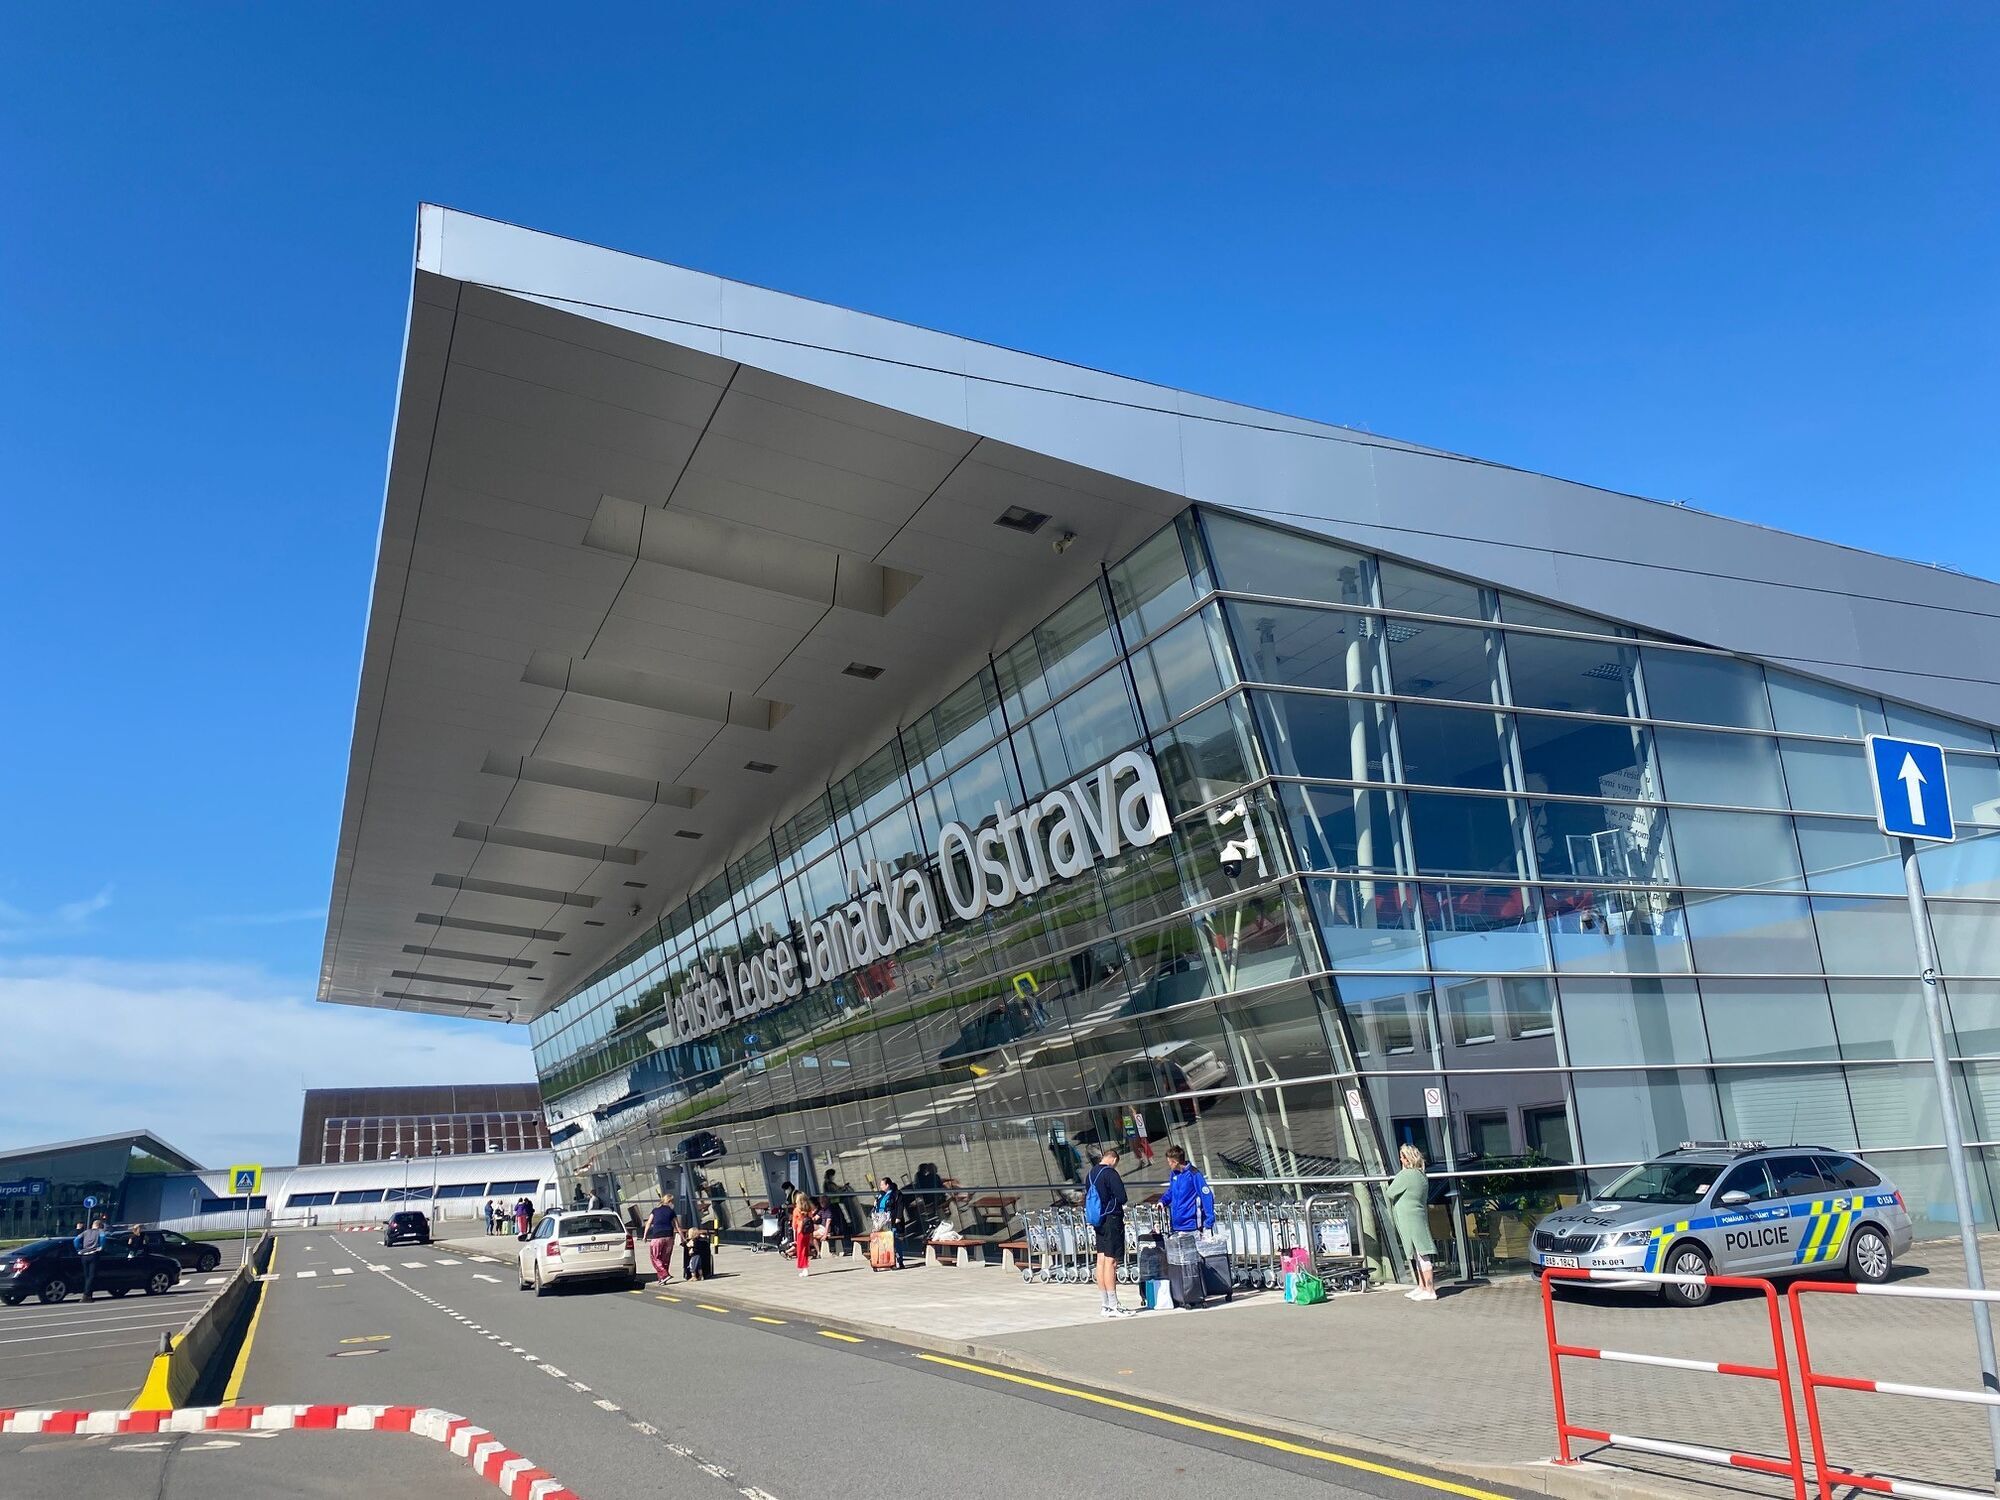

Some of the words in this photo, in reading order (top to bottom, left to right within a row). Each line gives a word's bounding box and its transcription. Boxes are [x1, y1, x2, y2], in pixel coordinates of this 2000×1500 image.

[722, 922, 803, 1020] Leoše
[803, 859, 941, 988] Janáčka
[938, 750, 1173, 920] Ostrava
[1547, 1215, 1616, 1227] POLICIE
[1725, 1226, 1789, 1251] POLICIE
